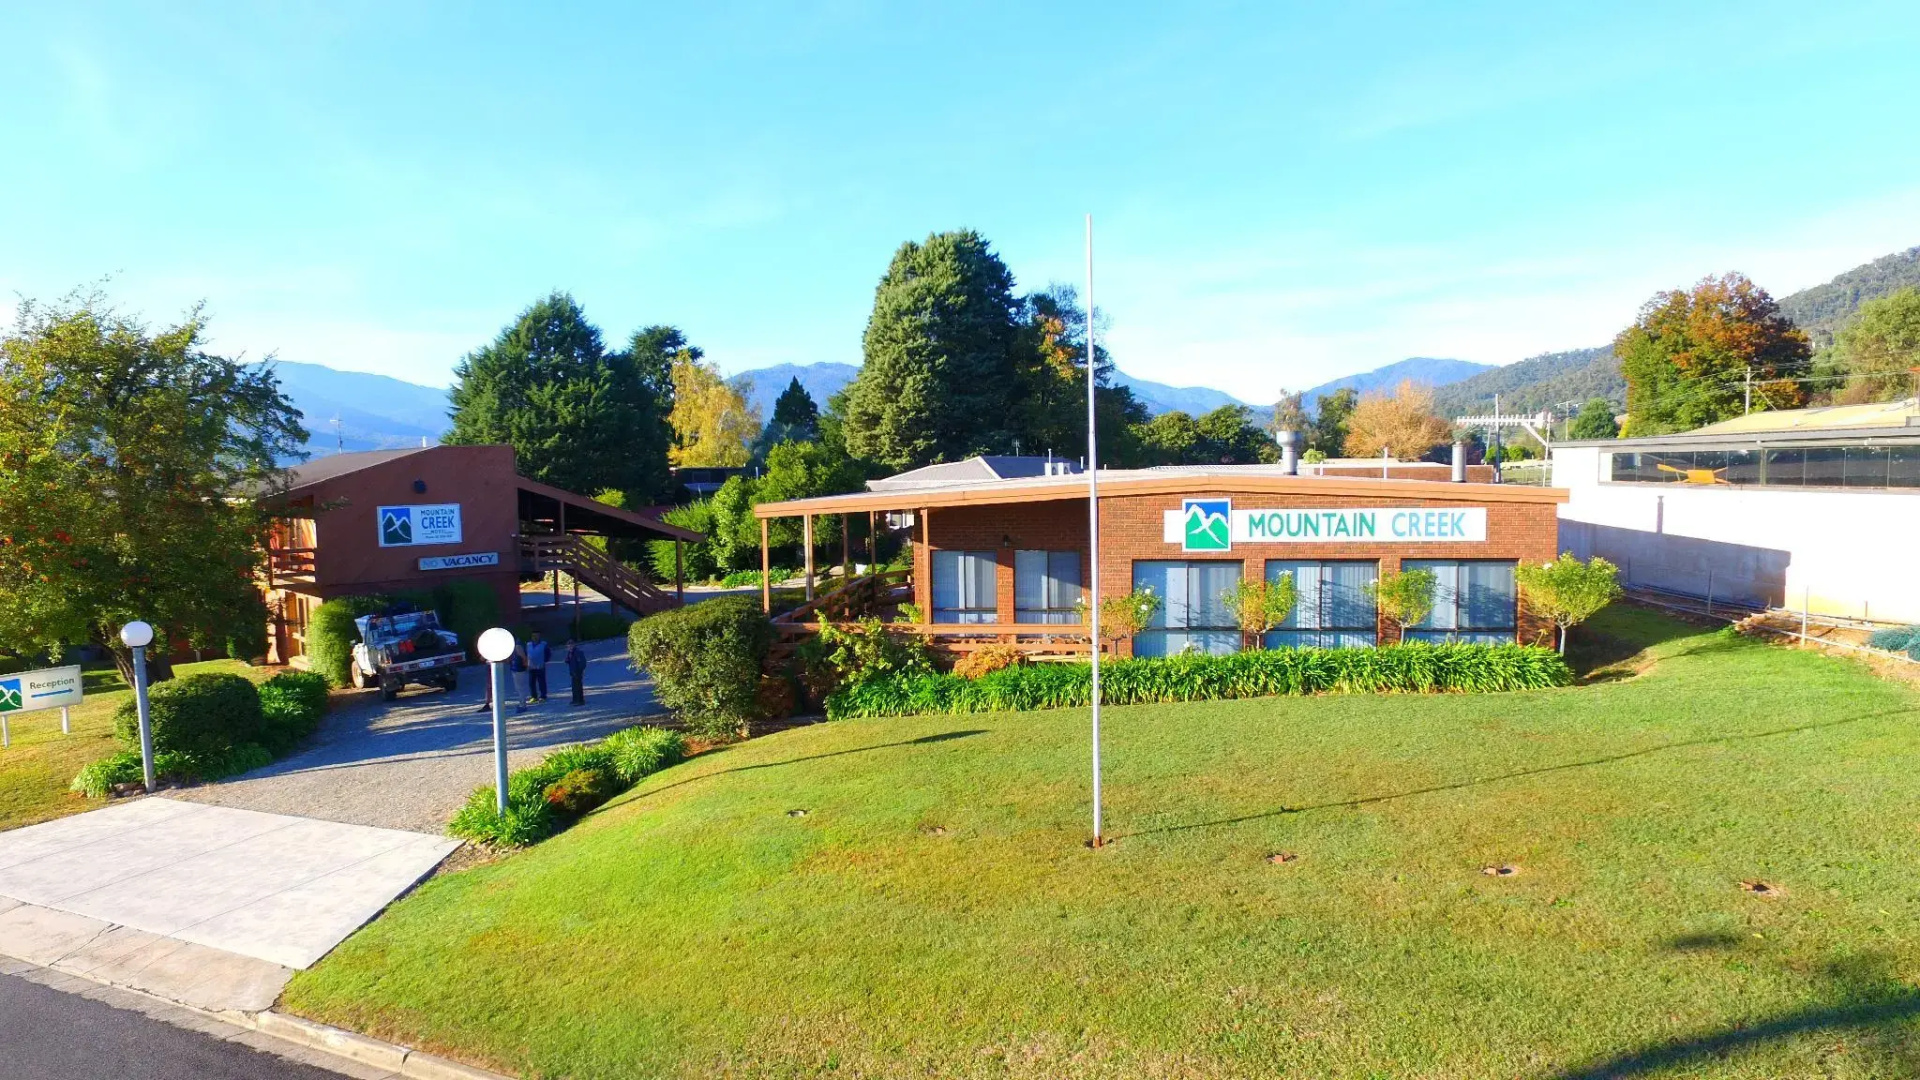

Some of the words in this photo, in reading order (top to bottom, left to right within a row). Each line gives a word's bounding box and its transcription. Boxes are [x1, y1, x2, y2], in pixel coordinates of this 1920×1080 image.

[420, 508, 455, 516] MOUNTAIN
[421, 516, 455, 529] CREEK
[1248, 512, 1375, 537] MOUNTAIN
[1391, 512, 1466, 537] CREEK
[423, 560, 438, 568] NO
[442, 555, 494, 567] VACANCY
[30, 678, 75, 689] Reception
